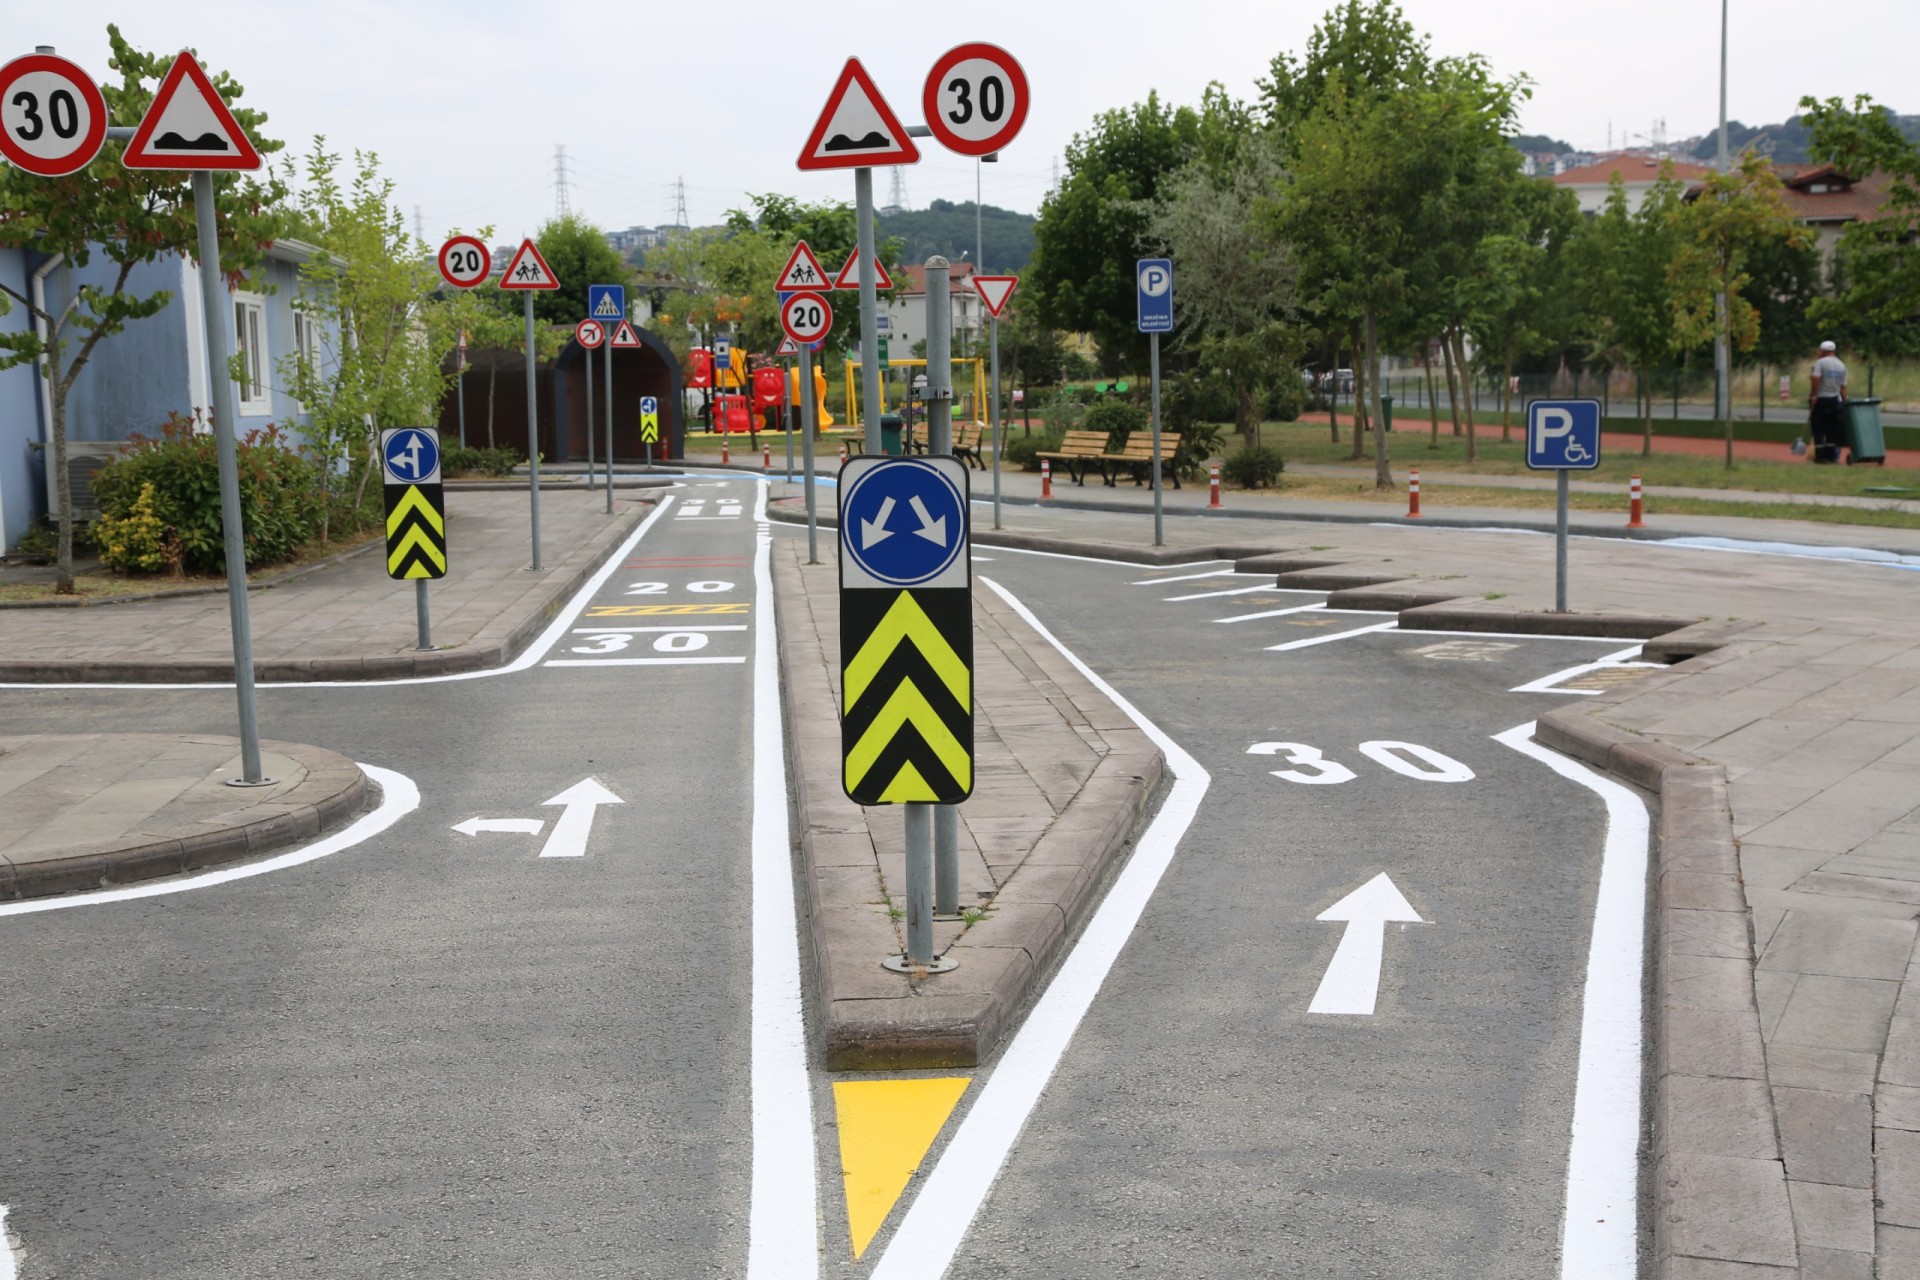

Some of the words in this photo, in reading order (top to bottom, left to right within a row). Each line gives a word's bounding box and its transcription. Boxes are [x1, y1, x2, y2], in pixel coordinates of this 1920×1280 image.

[947, 75, 1005, 125] 30
[12, 89, 79, 141] 30
[450, 250, 479, 273] 20
[1149, 271, 1163, 291] P
[793, 306, 821, 328] 20
[1535, 407, 1574, 454] P
[623, 580, 735, 595] 20
[571, 632, 709, 654] 30
[1246, 739, 1477, 785] 30
